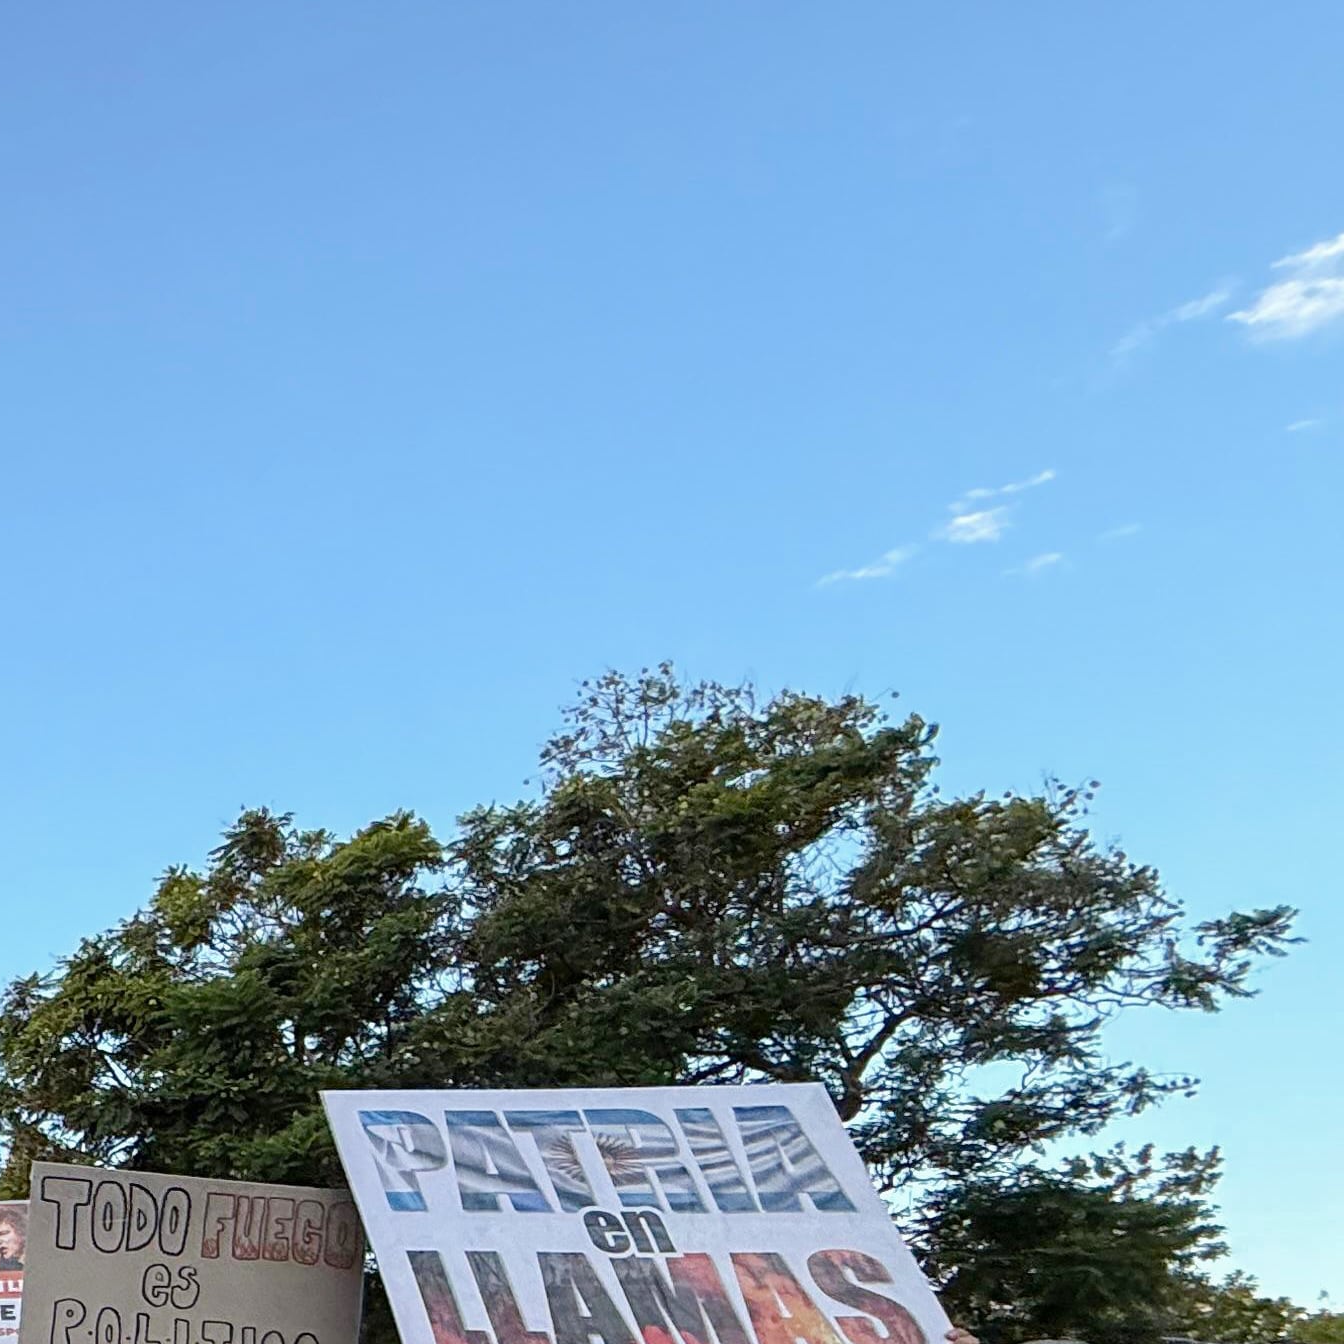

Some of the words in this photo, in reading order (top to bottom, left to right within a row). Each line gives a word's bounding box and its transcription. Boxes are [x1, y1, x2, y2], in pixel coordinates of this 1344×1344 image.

[358, 1105, 858, 1213] PATRIA
[41, 1175, 192, 1256] TODO
[200, 1191, 360, 1270] FUEGO
[583, 1207, 676, 1255] en
[141, 1263, 201, 1309] es
